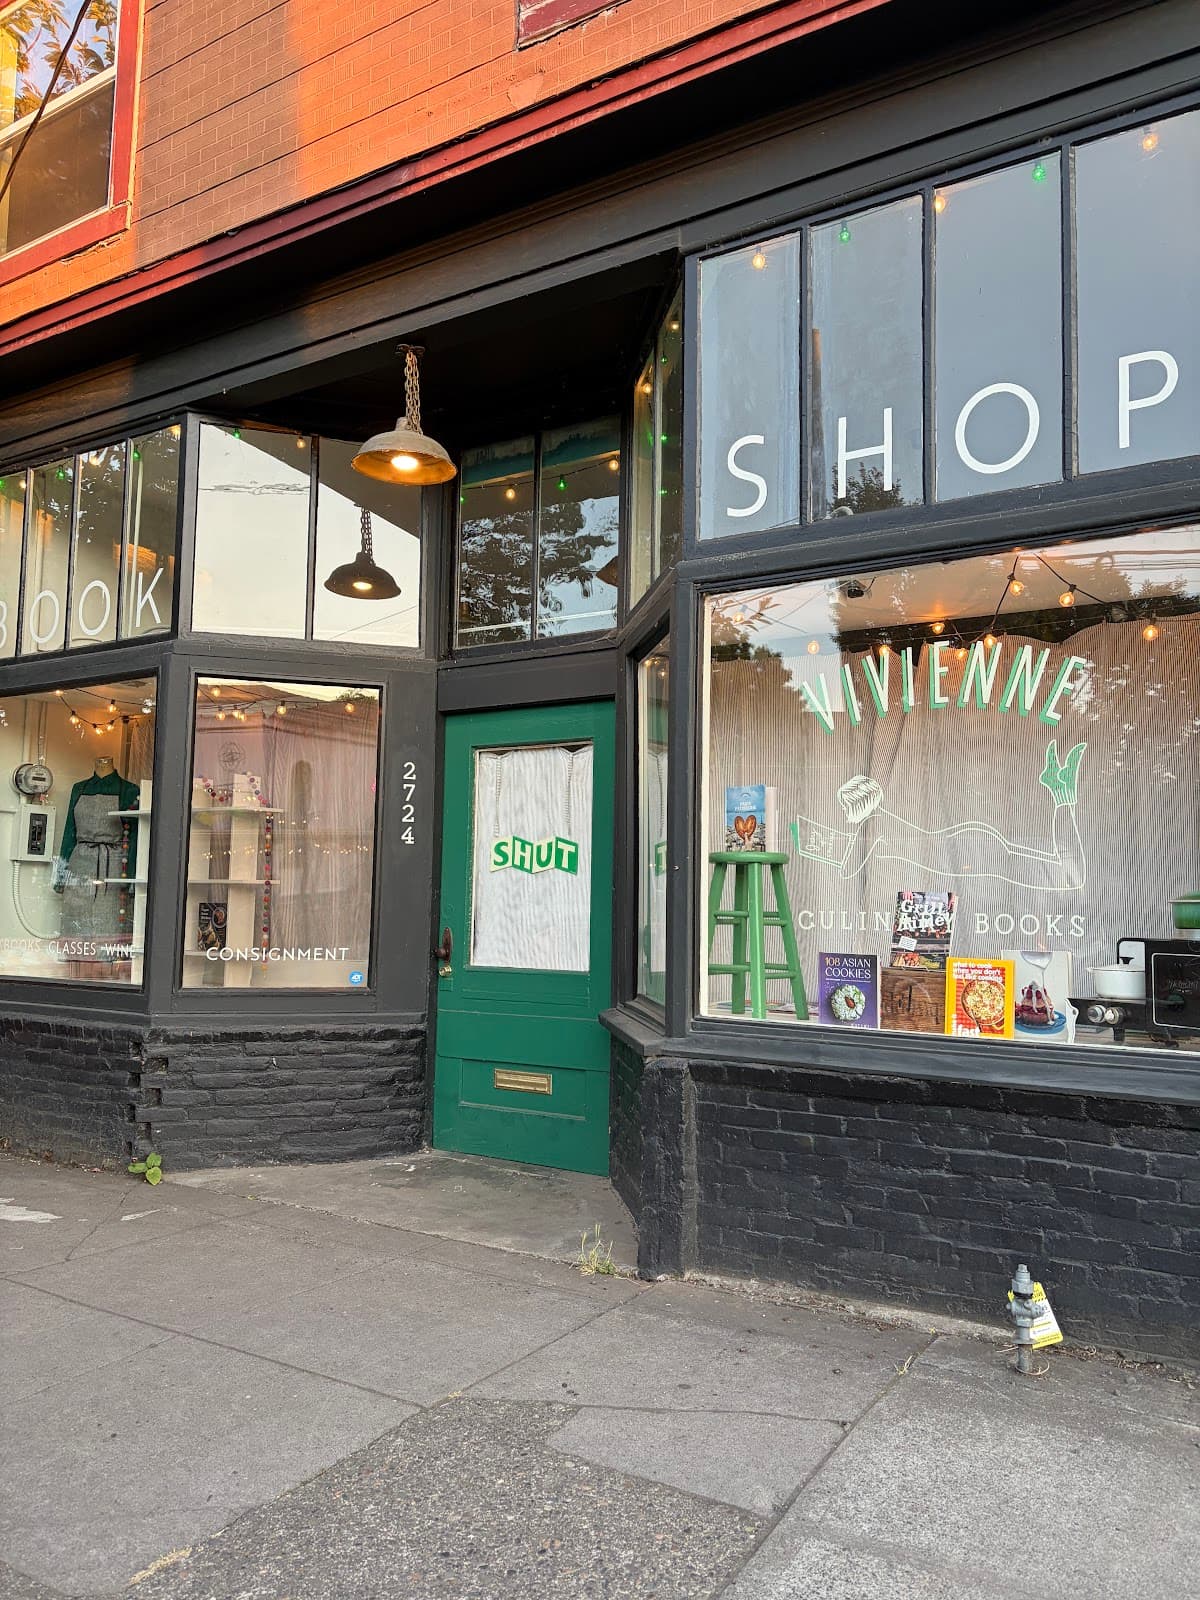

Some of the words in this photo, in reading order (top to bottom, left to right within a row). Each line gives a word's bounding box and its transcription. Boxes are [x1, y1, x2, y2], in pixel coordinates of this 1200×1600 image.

[726, 350, 1180, 519] SHOP
[801, 640, 1086, 734] VIVIENNE
[400, 761, 417, 845] 2724
[492, 839, 577, 871] SHUT
[974, 913, 1086, 937] BOOKS
[47, 940, 97, 956] CLASSES
[104, 943, 136, 959] WINE
[205, 947, 350, 961] CONSIGNMENT
[824, 956, 841, 967] 108
[841, 957, 871, 968] ASIAN
[824, 966, 871, 979] COOKIES
[978, 975, 1003, 983] cooking
[983, 968, 1001, 976] don't
[957, 1023, 980, 1038] fast
